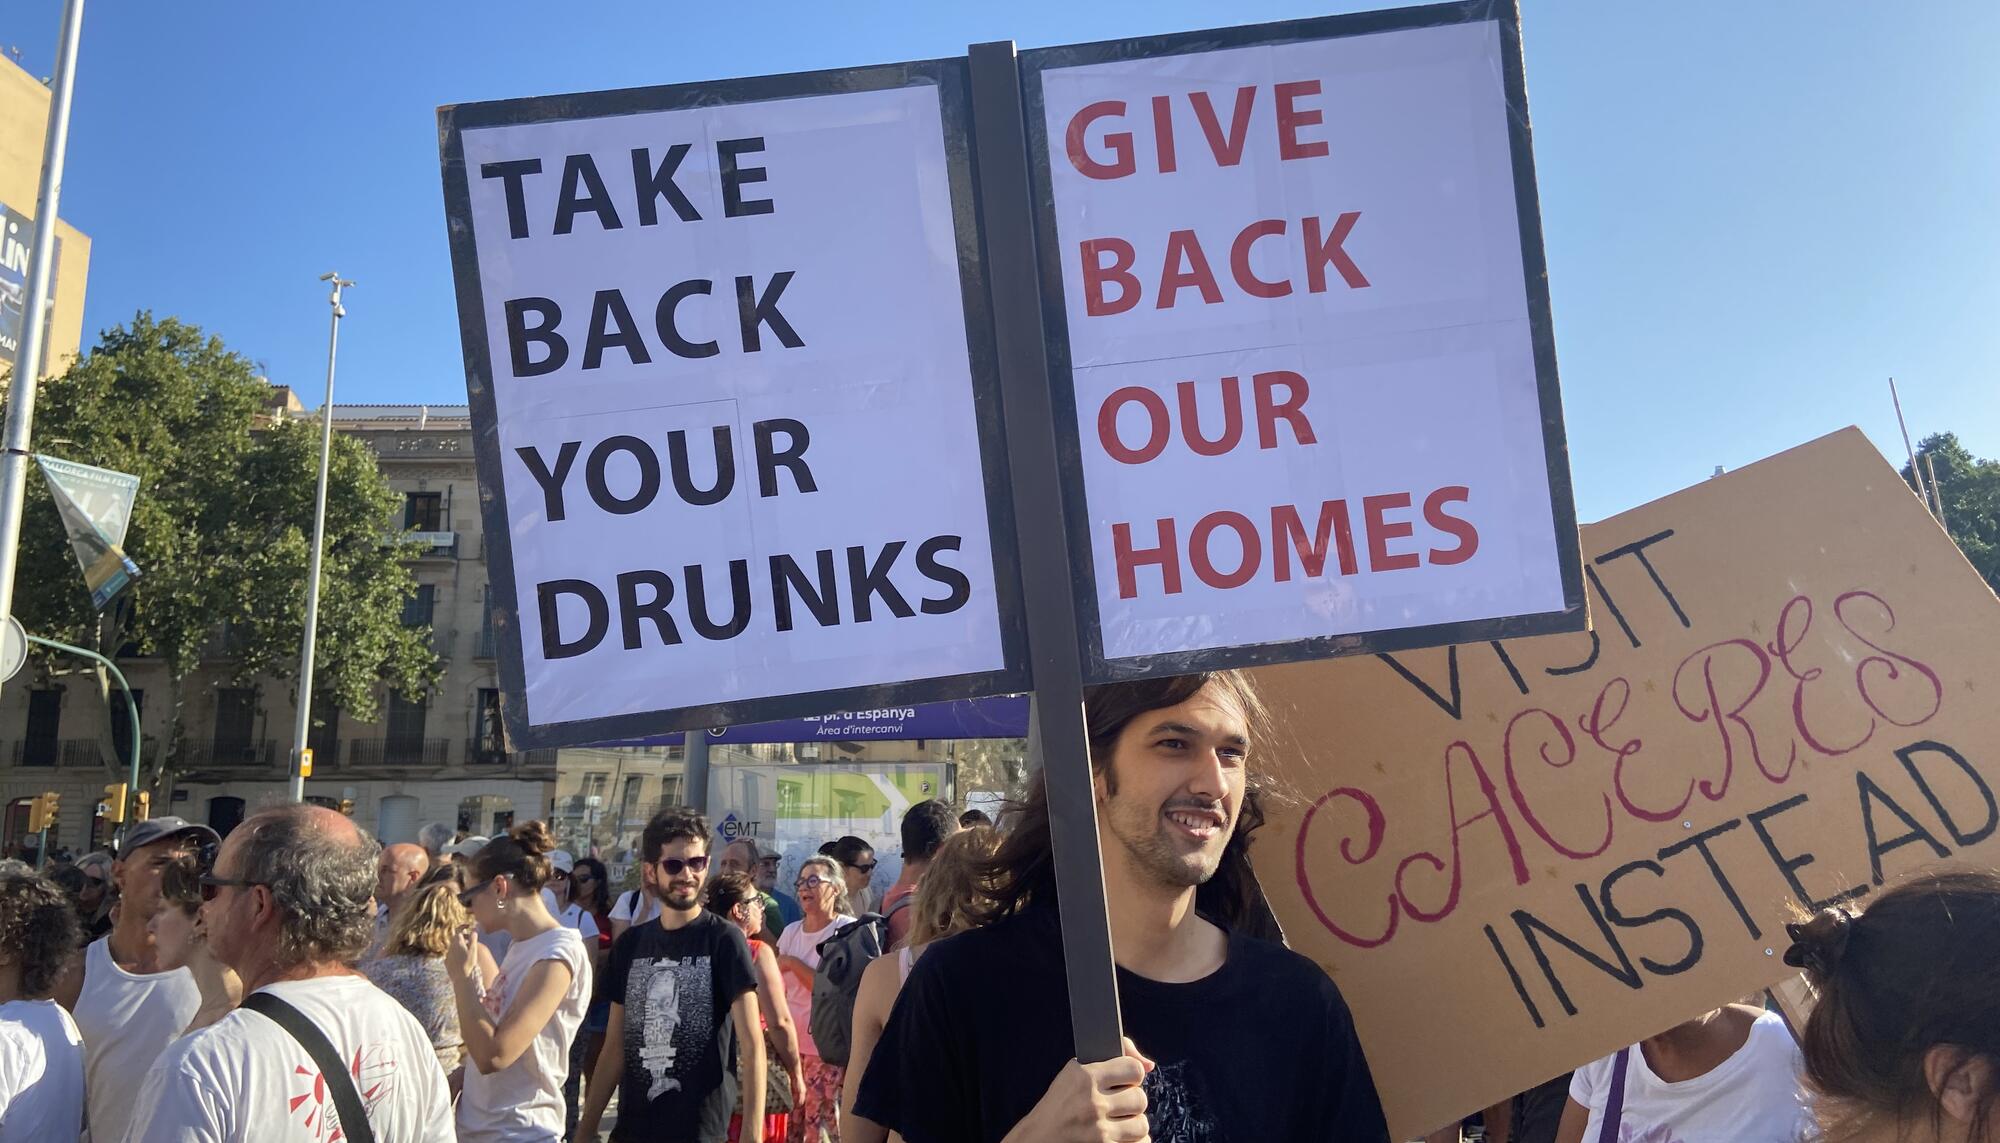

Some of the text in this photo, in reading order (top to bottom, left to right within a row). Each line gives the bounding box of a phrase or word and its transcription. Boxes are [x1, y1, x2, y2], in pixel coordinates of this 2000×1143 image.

[1065, 80, 1329, 180] GIVE
[481, 137, 774, 239] TAKE
[1080, 211, 1371, 317] BACK
[505, 271, 805, 377] BACK
[515, 418, 818, 521] YOUR
[1098, 370, 1317, 465] OUR
[1112, 486, 1479, 599] HOMES
[537, 535, 971, 659] DRUNKS
[816, 723, 903, 736] Àrea d'intercanvi
[1296, 591, 1941, 948] CACERES
[1484, 739, 1999, 1028] INSTEAD
